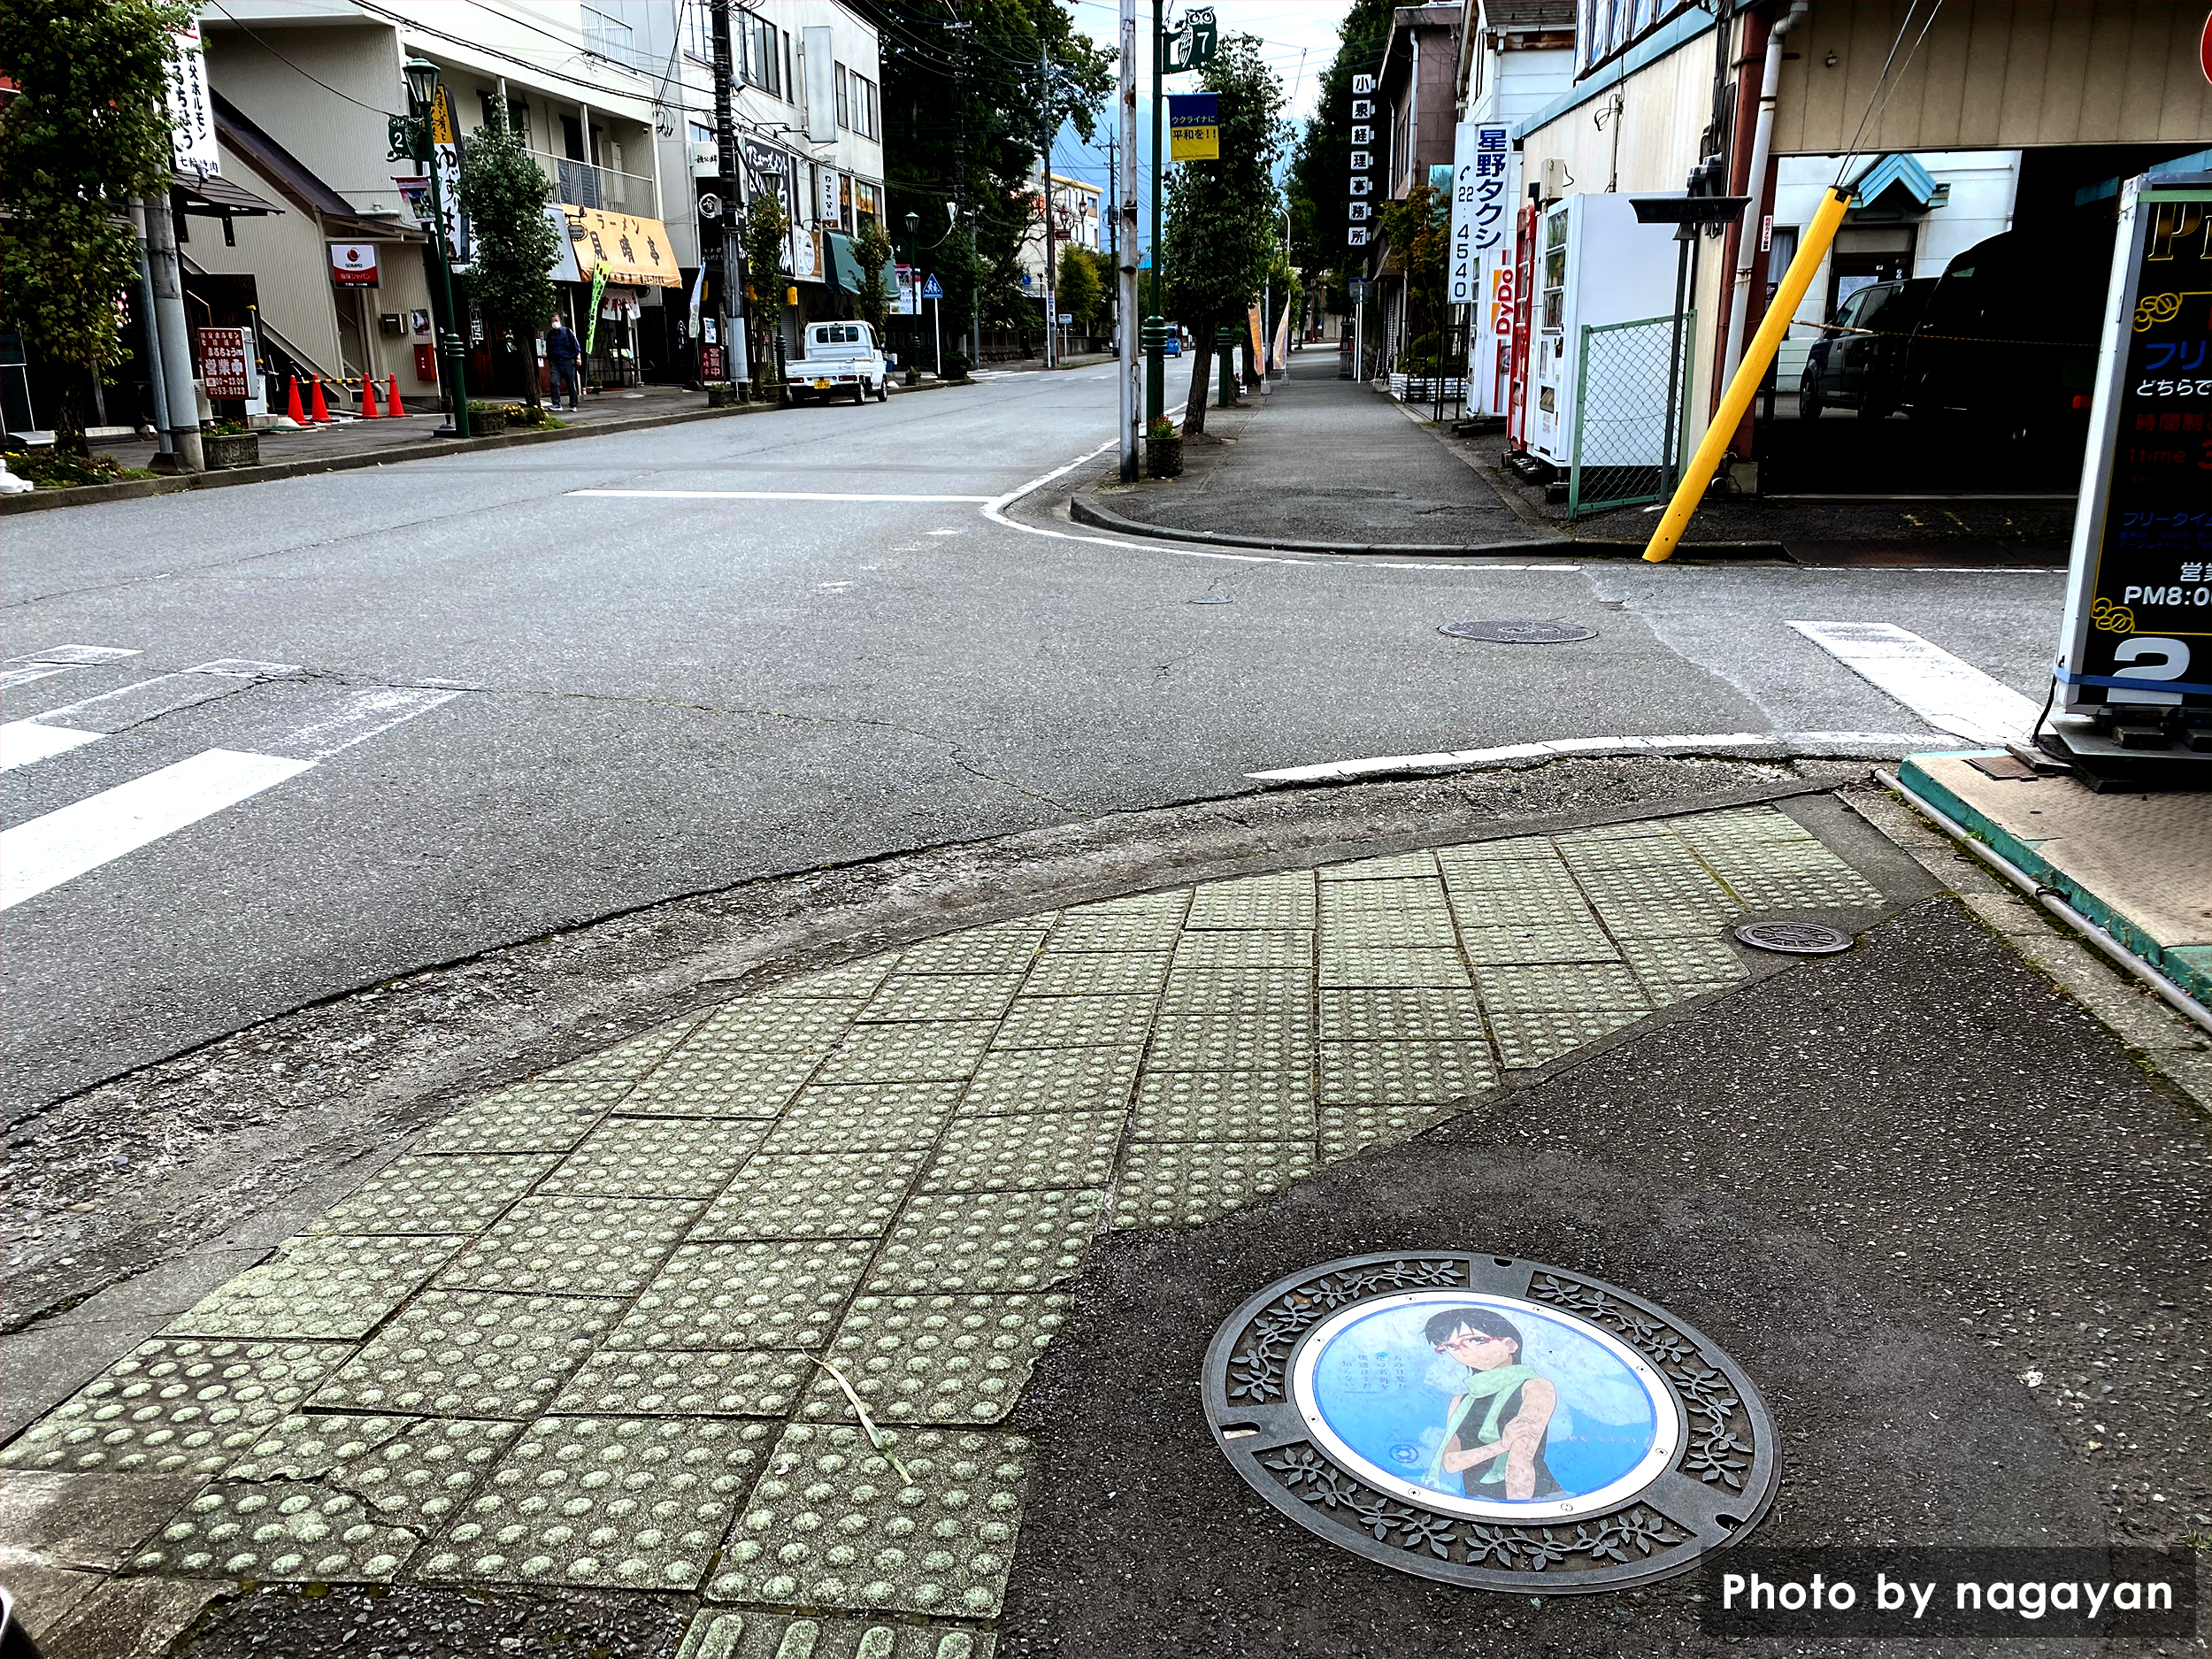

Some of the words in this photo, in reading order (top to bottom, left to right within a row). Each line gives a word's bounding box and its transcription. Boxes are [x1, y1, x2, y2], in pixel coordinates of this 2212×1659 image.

[1197, 31, 1210, 54] 7
[1171, 116, 1216, 125] ウクライナに
[394, 132, 403, 148] 2
[1350, 76, 1370, 243] 小泉経理事務所
[596, 213, 640, 234] ラーメン
[2148, 202, 2212, 260] P
[1496, 269, 1514, 335] DyDo
[205, 358, 243, 375] 営業中
[709, 348, 720, 376] 営業中
[2137, 380, 2212, 396] どちらで
[2136, 413, 2212, 431] 時間制
[2124, 586, 2212, 606] PM8:0
[2107, 637, 2190, 705] 2
